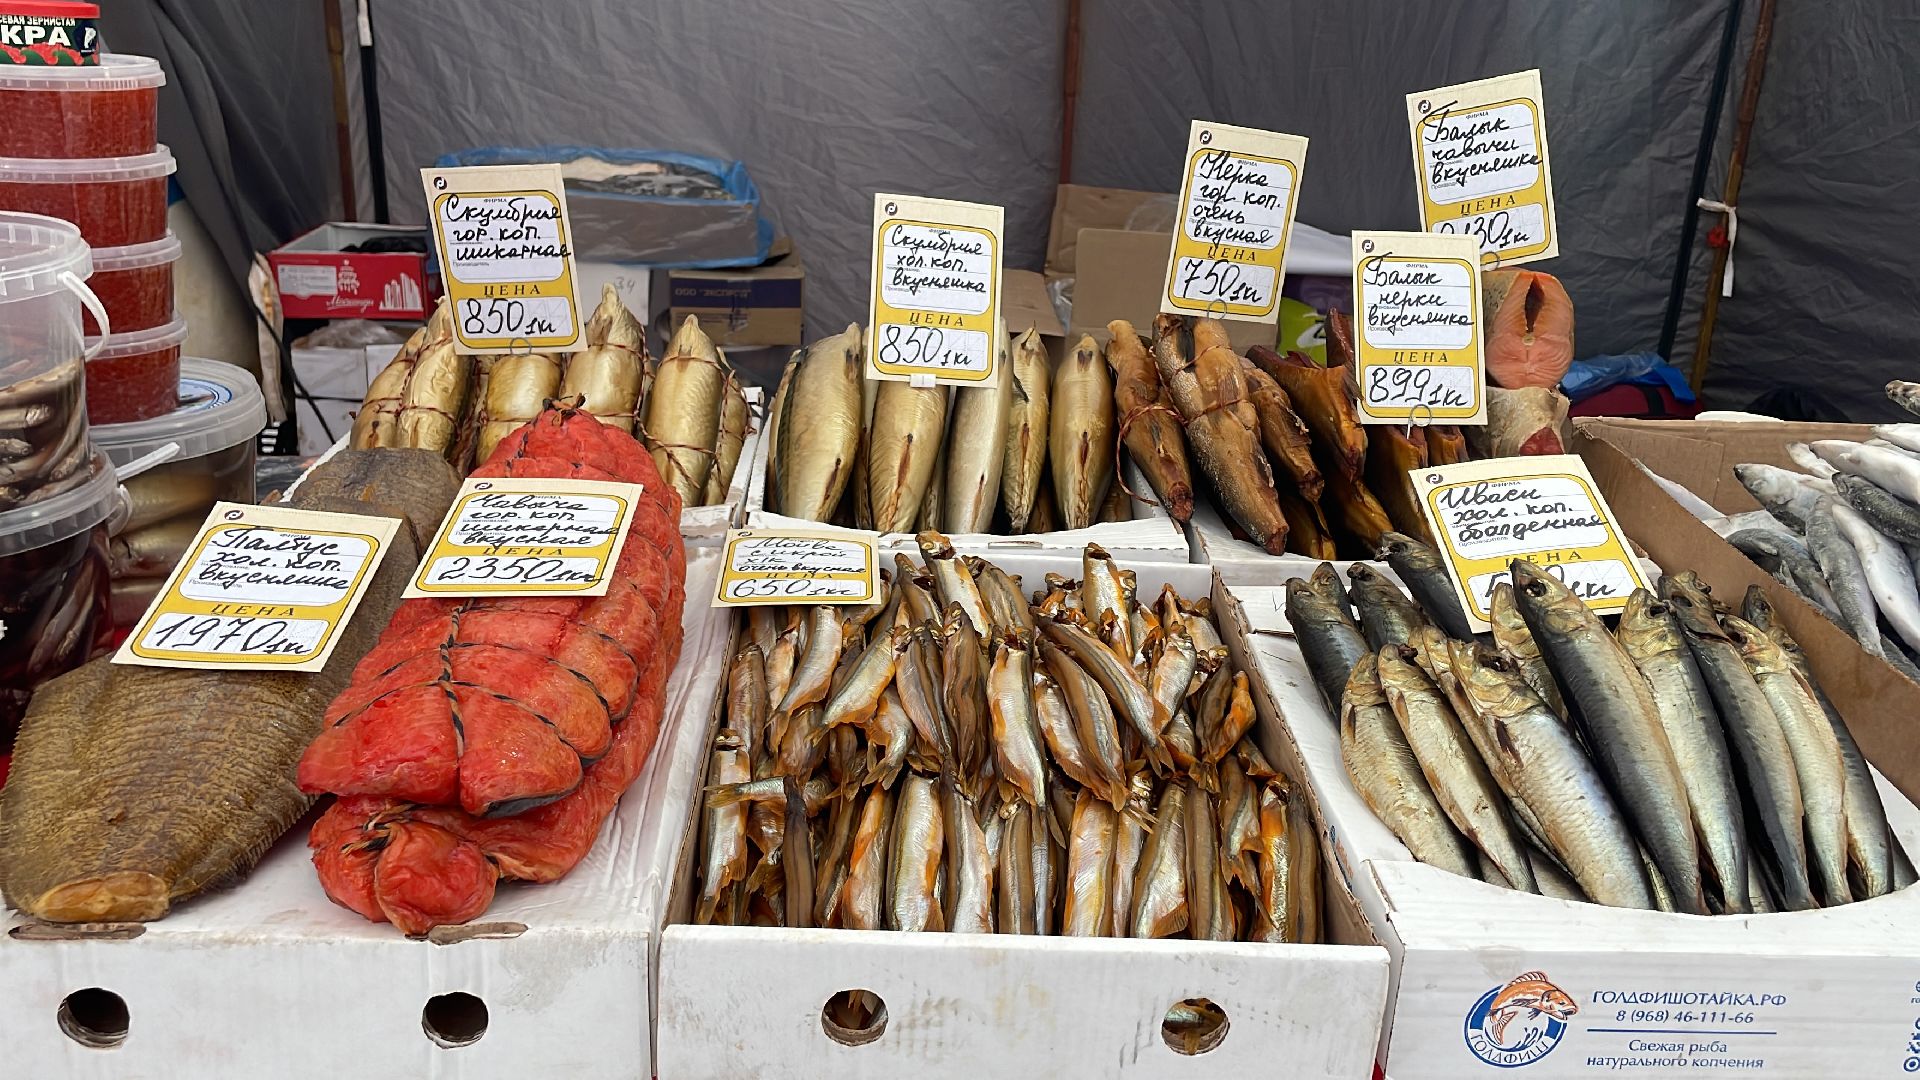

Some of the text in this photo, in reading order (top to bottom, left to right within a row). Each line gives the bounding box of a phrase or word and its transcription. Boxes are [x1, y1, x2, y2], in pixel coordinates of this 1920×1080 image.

[27, 17, 75, 26] ЗЕРНИСТАЯ
[1423, 100, 1510, 142] Балык
[1200, 151, 1269, 188] Нерка
[1432, 153, 1543, 187] вкусняшка
[446, 193, 563, 228] Скумбрия
[1243, 191, 1281, 210] коп.
[1460, 195, 1516, 216] ЦЕНА
[1193, 204, 1245, 224] очень
[453, 226, 541, 242] гор. коп.
[891, 224, 983, 259] Скумбрия
[1194, 218, 1273, 247] вкусная
[457, 244, 572, 260] шикарная
[1207, 247, 1257, 262] ЦЕНА
[931, 257, 968, 272] коп.
[1364, 252, 1442, 286] Балык
[893, 267, 986, 296] вкусняшка
[1184, 259, 1240, 298] 750
[484, 284, 541, 298] ЦЕНА
[1379, 291, 1447, 312] нерки
[464, 298, 524, 334] 850
[909, 312, 964, 326] ЦЕНА
[1368, 304, 1474, 336] вкусняшка
[880, 325, 943, 364] 850
[1394, 352, 1448, 364] ЦЕНА
[1370, 367, 1431, 403] 899
[470, 494, 590, 511] Чавыча
[1440, 481, 1542, 509] Иваси
[1526, 501, 1573, 515] коп.
[461, 523, 620, 536] шикарная
[1459, 517, 1609, 541] обалденная
[211, 526, 341, 556] Палтус
[463, 532, 592, 549] вкусная
[483, 548, 563, 556] ЦЕНА
[285, 554, 341, 572] коп.
[438, 557, 564, 583] 2350
[200, 564, 349, 590] вкусняшка
[734, 579, 812, 597] 650
[210, 604, 295, 616] ЦЕНА
[156, 616, 287, 651] 1970
[1592, 991, 1786, 1006] ГОЛДФИШОТАЙКА.РФ
[1616, 1010, 1754, 1024] 8 (968) 46-111-66
[1471, 1034, 1549, 1064] ГОЛДФИШ
[1629, 1040, 1727, 1055] Свежая рыба
[1587, 1056, 1764, 1069] натурального копчения
